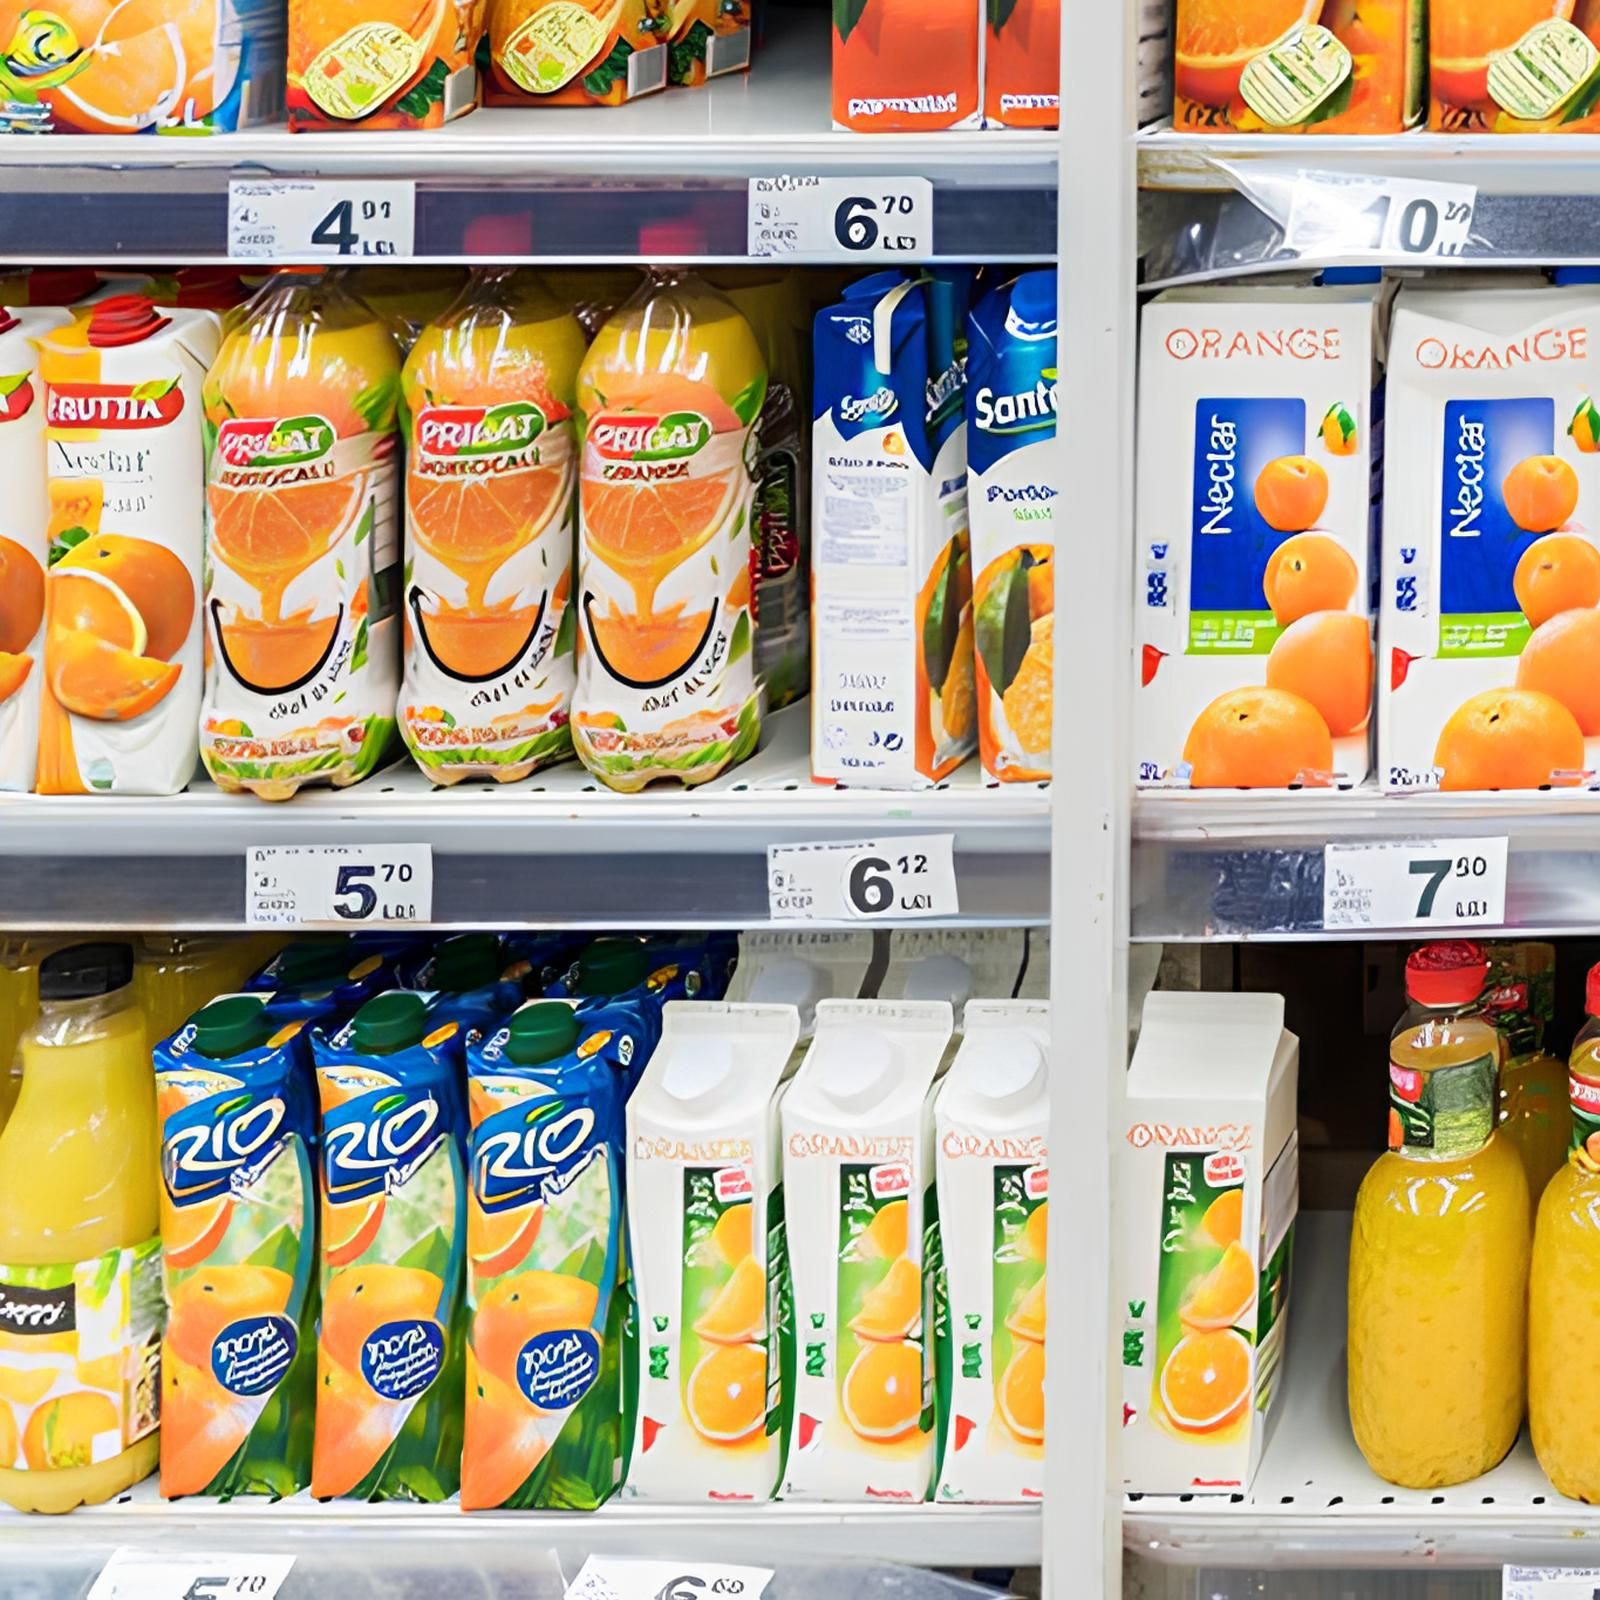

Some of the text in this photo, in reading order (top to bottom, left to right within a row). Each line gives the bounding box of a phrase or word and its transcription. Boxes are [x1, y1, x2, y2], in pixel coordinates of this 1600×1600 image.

[312, 200, 358, 254] 4
[834, 197, 878, 250] 6
[1165, 328, 1341, 361] ORANGE
[334, 865, 376, 918] 5
[849, 857, 895, 914] 6
[1408, 861, 1453, 918] 7
